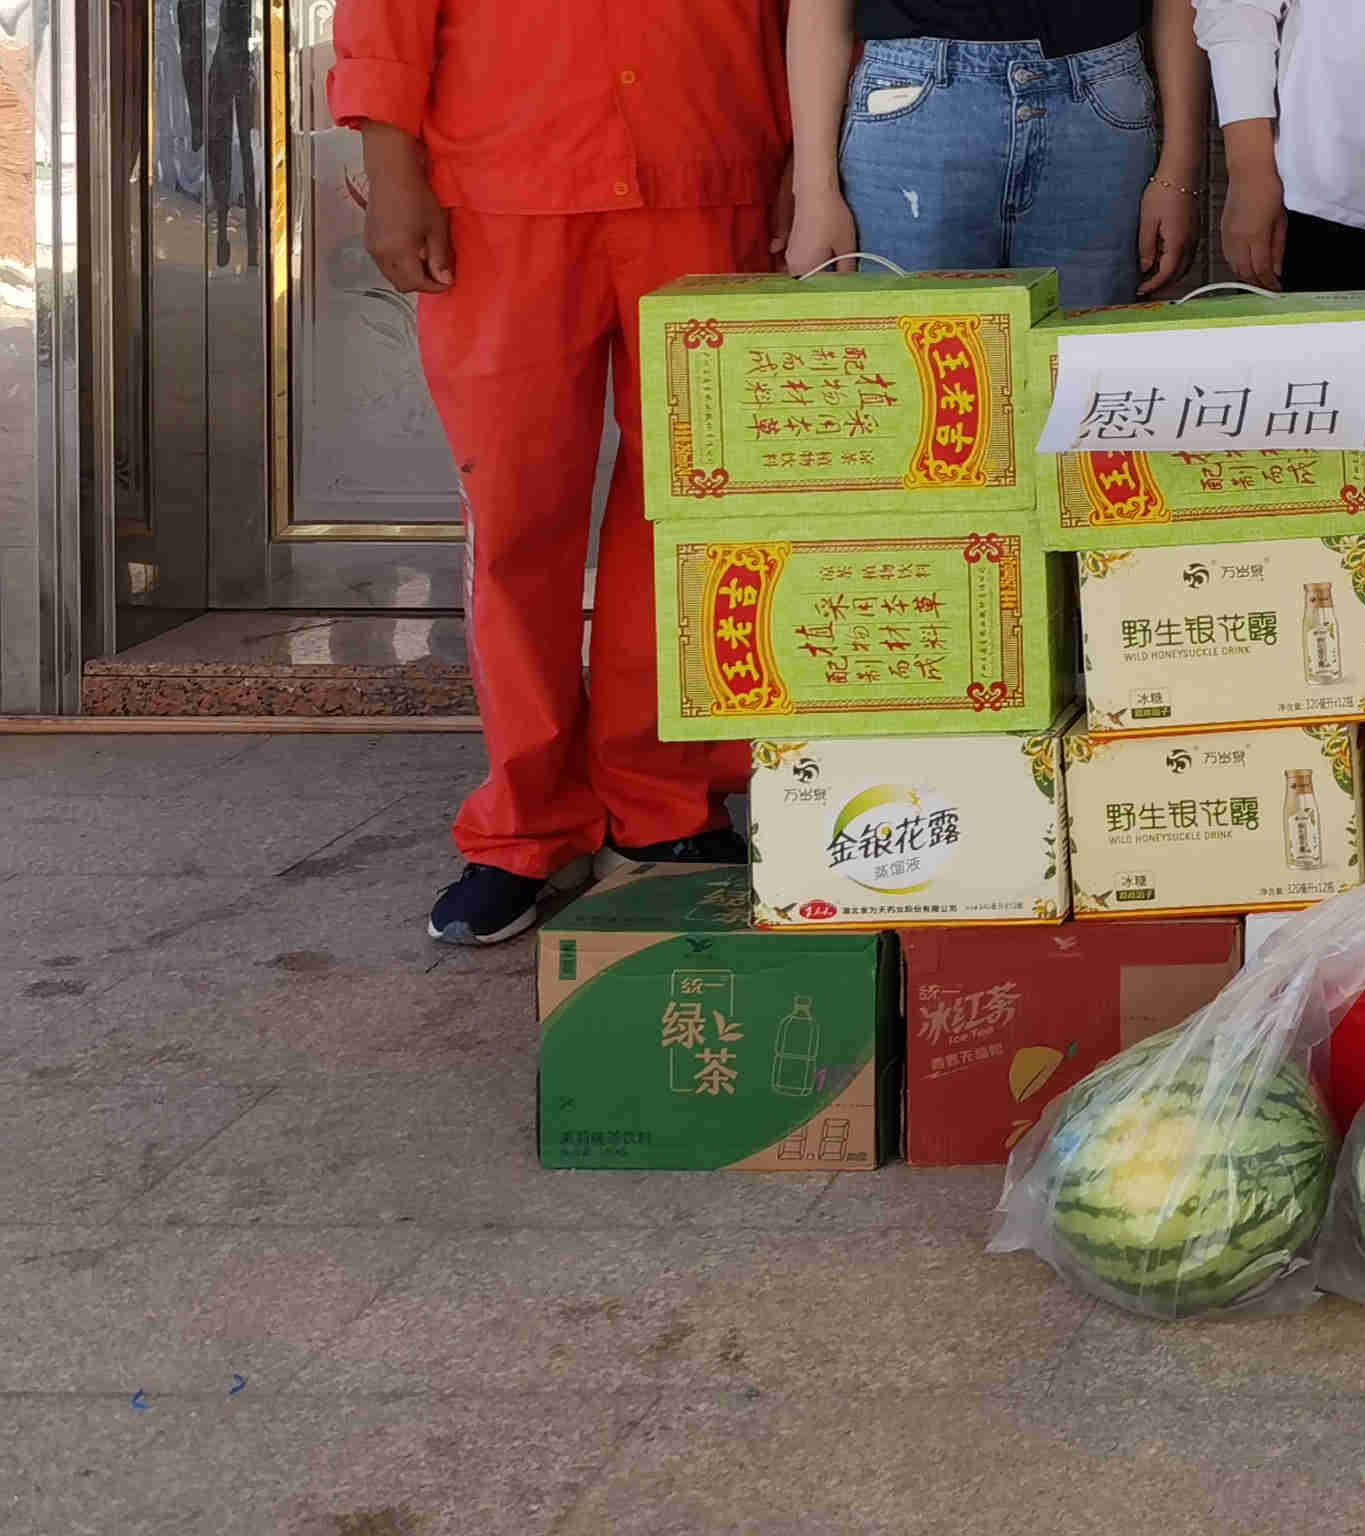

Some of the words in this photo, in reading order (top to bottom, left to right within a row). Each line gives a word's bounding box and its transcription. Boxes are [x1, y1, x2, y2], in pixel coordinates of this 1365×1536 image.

[931, 344, 975, 453] 王老吉
[1080, 380, 1339, 440] 慰问品
[718, 576, 761, 682] 王老吉
[1121, 610, 1280, 649] 野生银花露
[1124, 652, 1149, 663] WILD
[1151, 647, 1219, 662] HONEYSUCKLE
[1221, 645, 1251, 657] DRINK
[827, 807, 960, 868] 金银花露
[1106, 797, 1259, 833] 野生银花露
[1108, 835, 1133, 845] WILD
[1135, 831, 1201, 844] HONEYSUCKLE
[1204, 830, 1233, 841] DRINK
